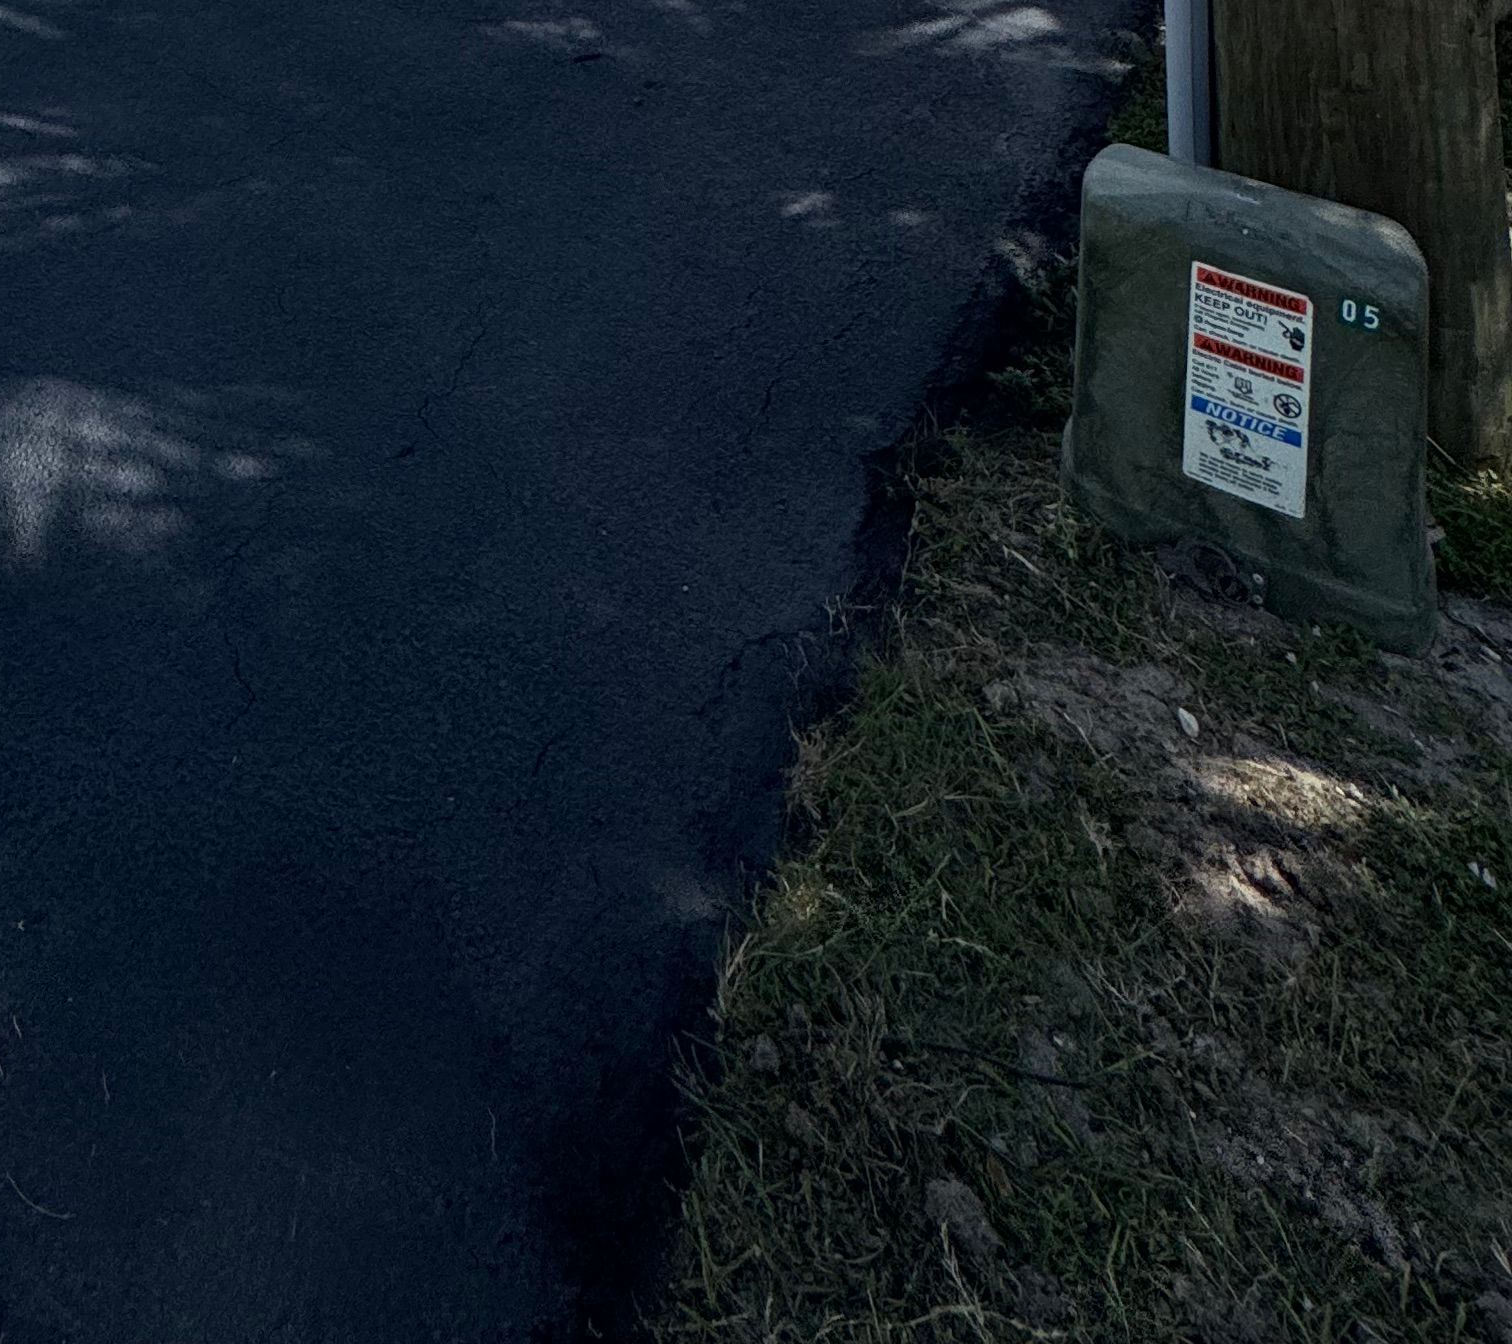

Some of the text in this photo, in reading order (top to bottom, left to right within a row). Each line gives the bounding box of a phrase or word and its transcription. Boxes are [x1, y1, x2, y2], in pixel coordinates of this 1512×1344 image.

[1194, 281, 1243, 305] Electrical
[1194, 291, 1230, 313] KEEP
[1233, 304, 1267, 325] OUT!
[1216, 273, 1300, 314] WARNING
[1214, 339, 1298, 381] WARNING
[1205, 402, 1289, 441] NOTICE
